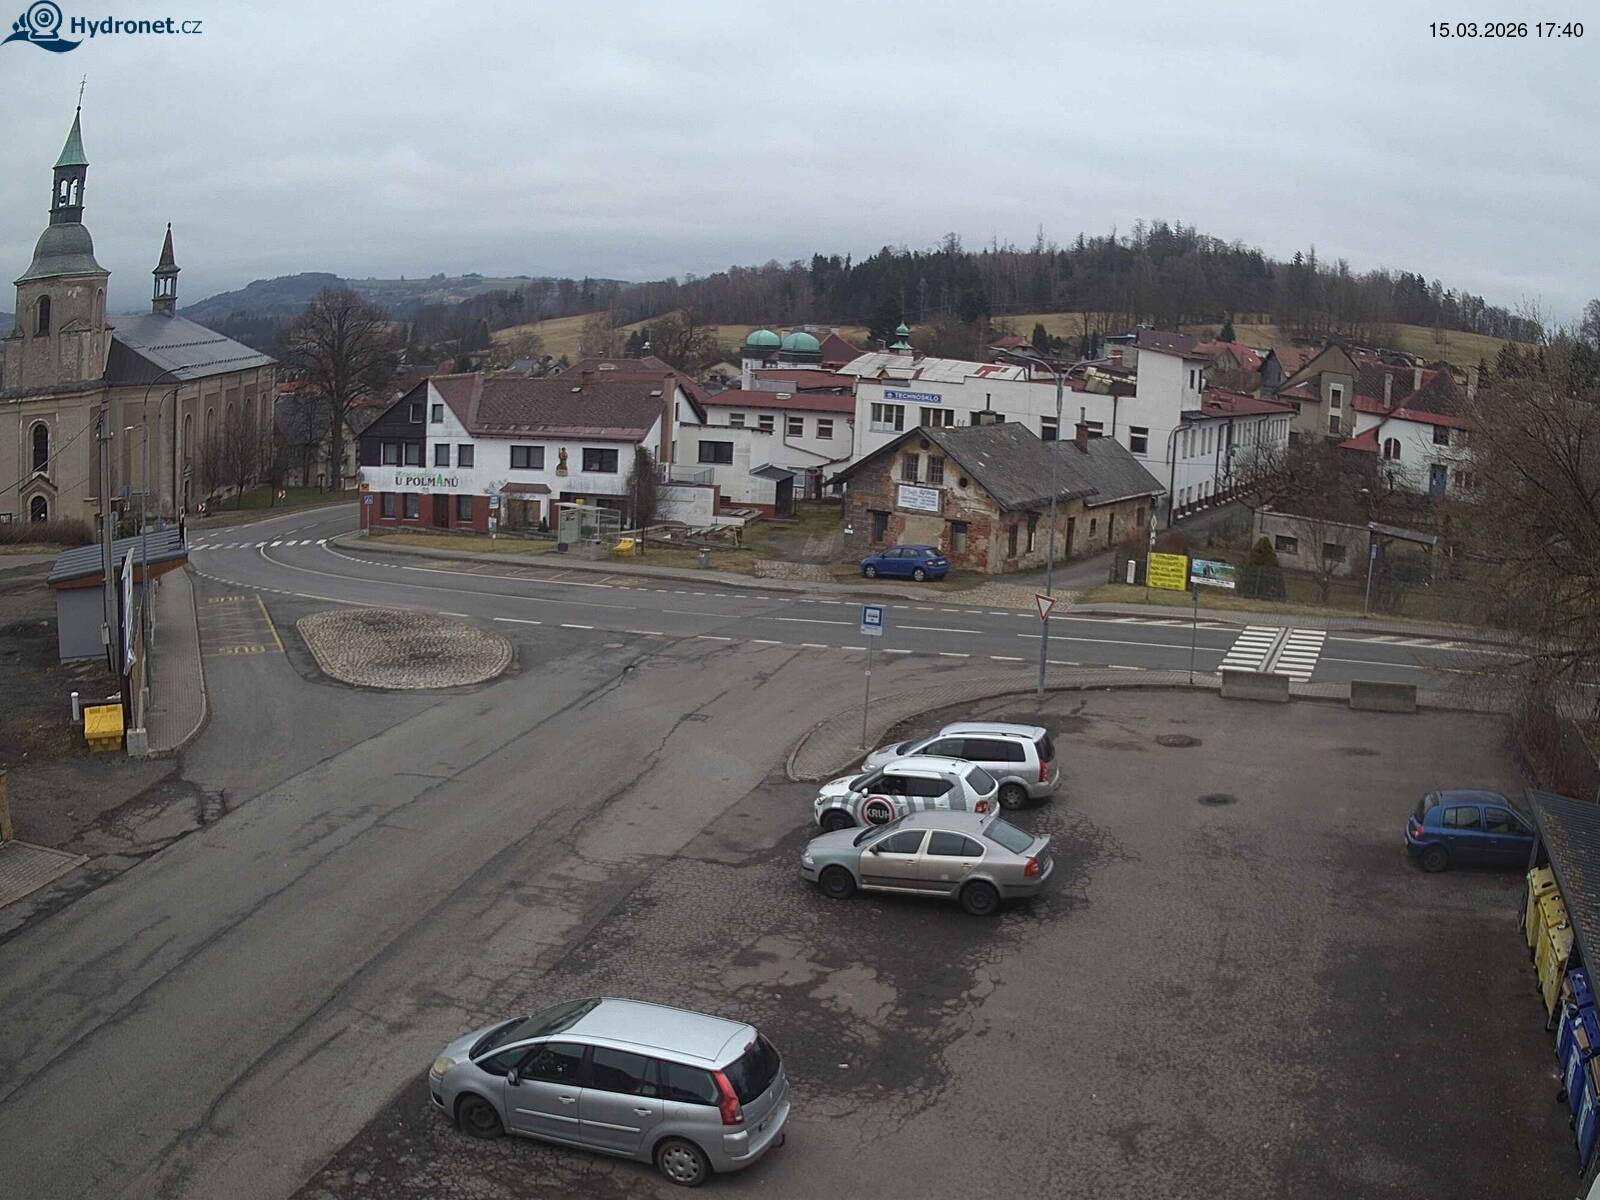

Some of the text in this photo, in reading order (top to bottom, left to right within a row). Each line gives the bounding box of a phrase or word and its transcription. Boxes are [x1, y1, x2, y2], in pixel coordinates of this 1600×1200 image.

[895, 392, 939, 402] TECHNOSKLO
[395, 476, 403, 486] U
[867, 808, 890, 820] KRUH
